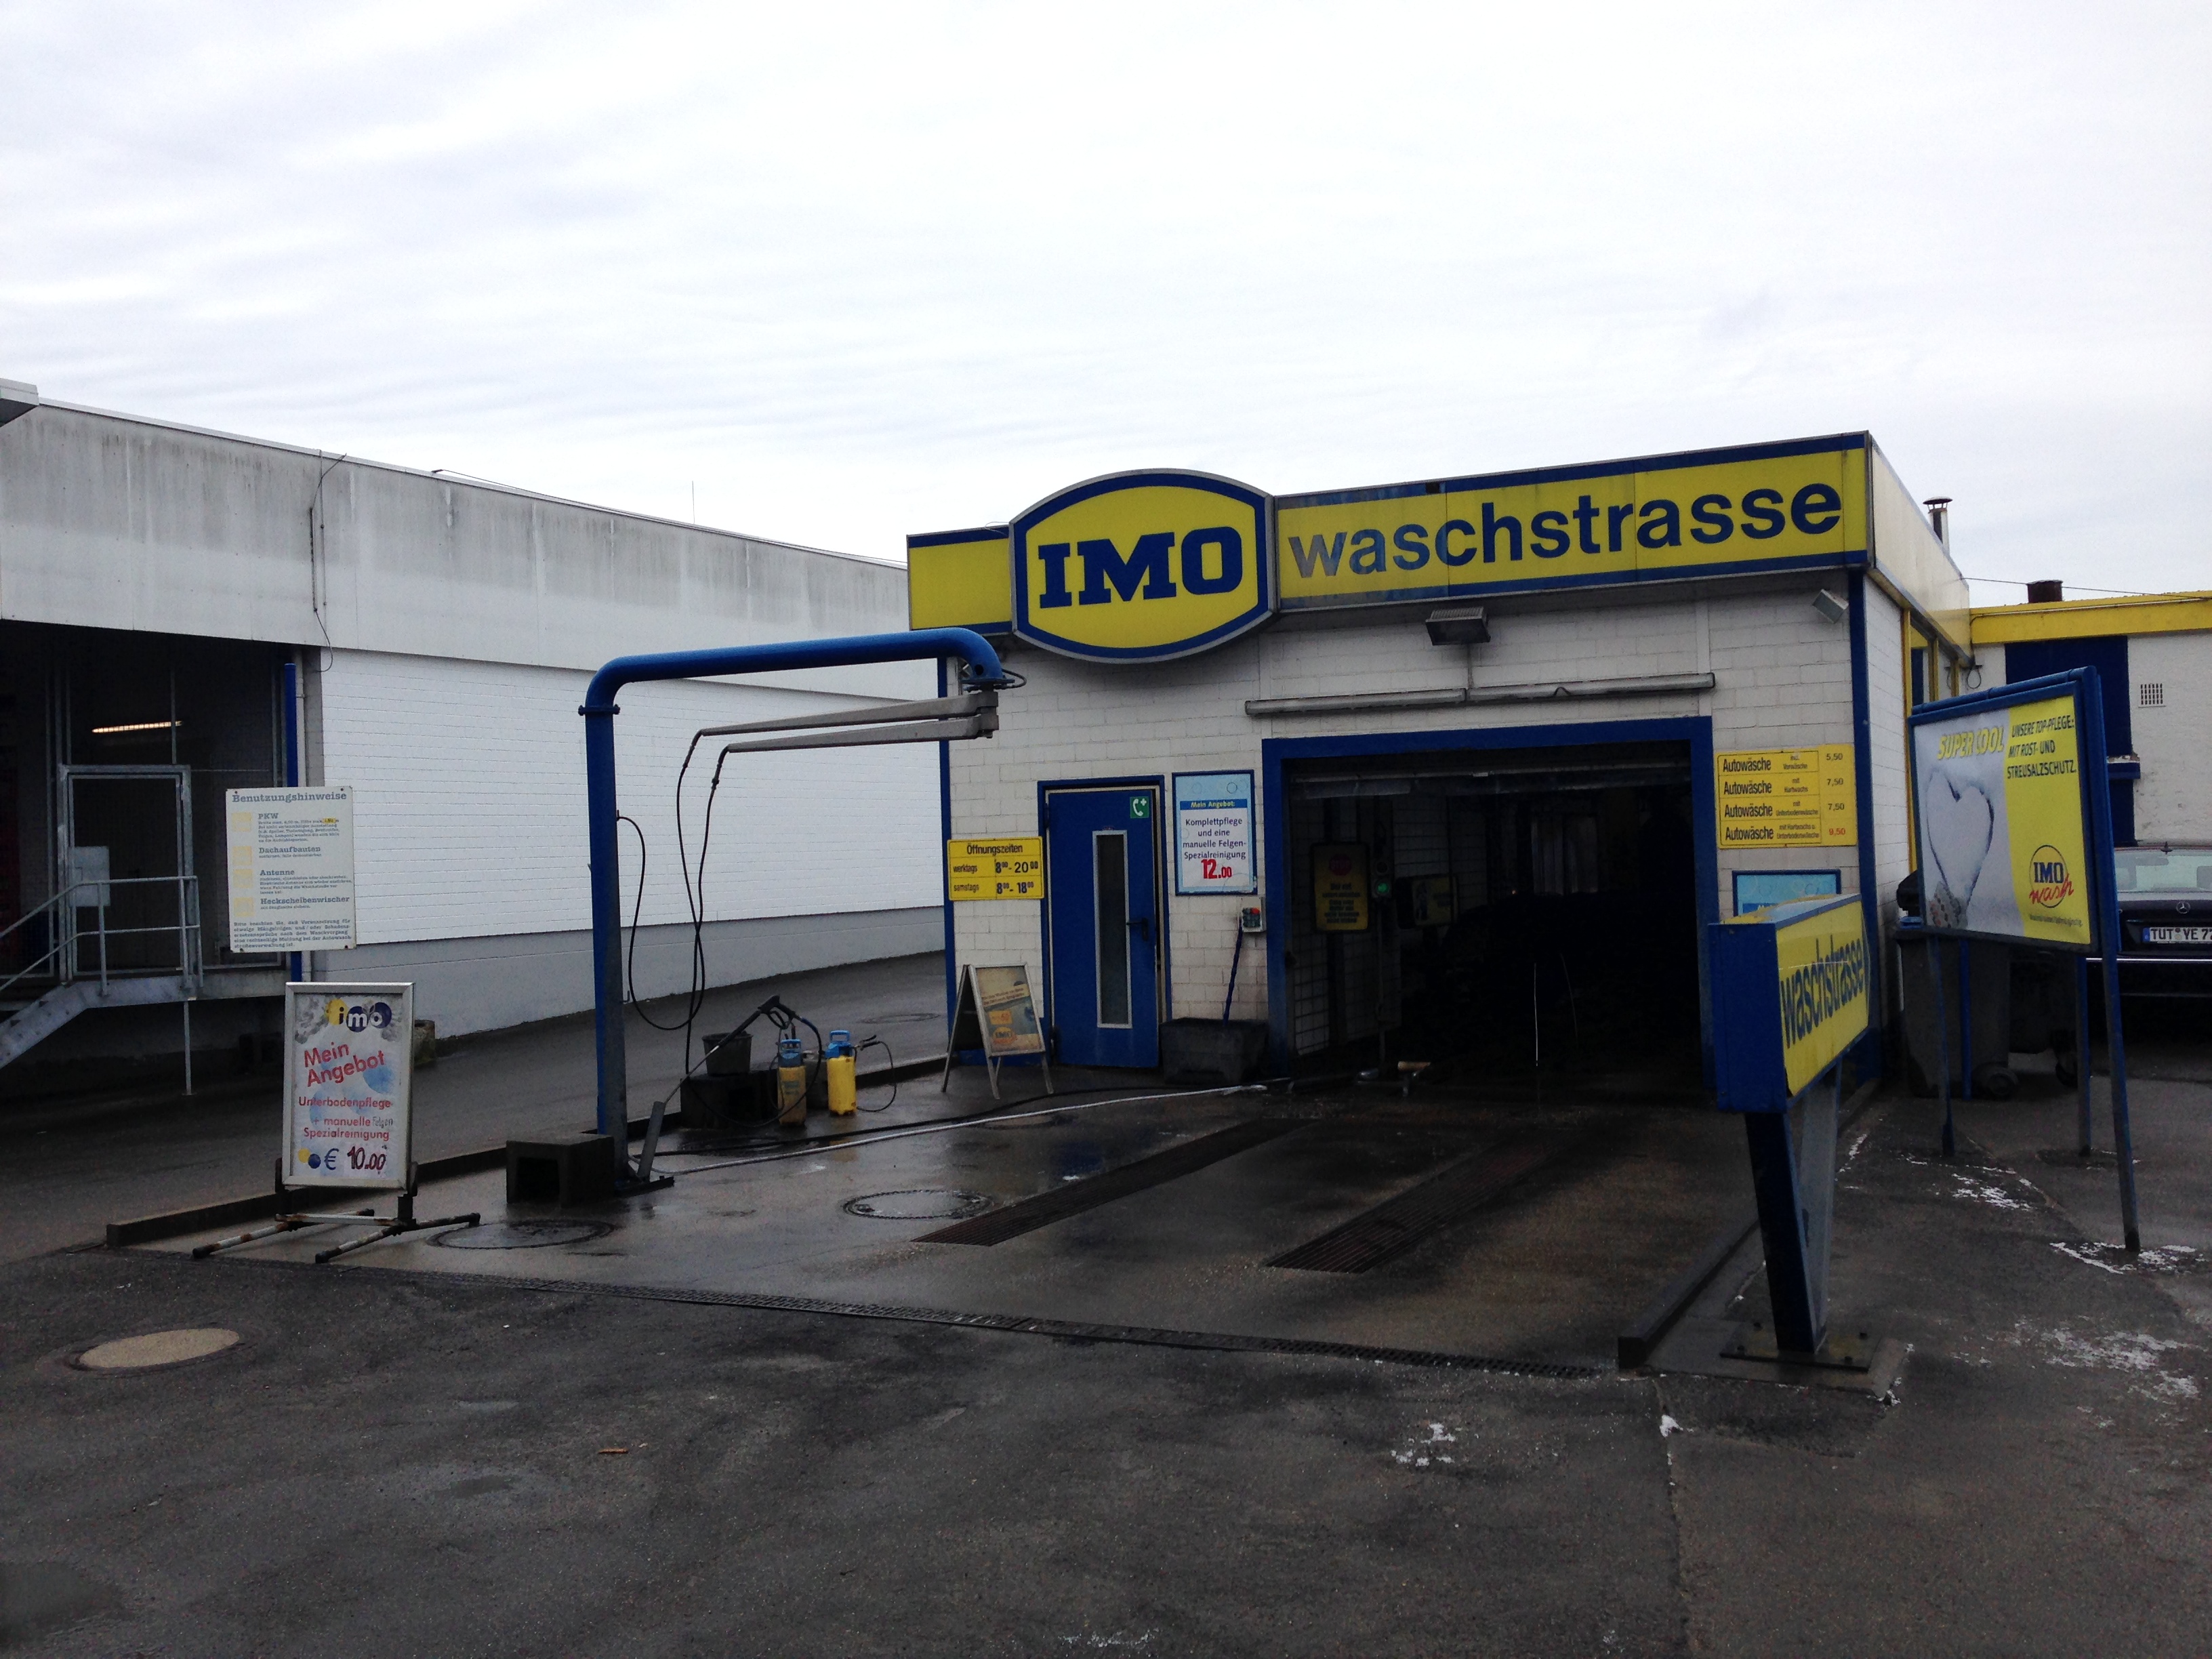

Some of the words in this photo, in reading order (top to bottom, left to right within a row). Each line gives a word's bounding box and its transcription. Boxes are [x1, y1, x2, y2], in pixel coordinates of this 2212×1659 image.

[1288, 482, 1841, 579] waschstrasse
[1038, 526, 1243, 609] IMO
[2012, 722, 2035, 737] UNSERE
[2036, 715, 2074, 733] TOP-PFLEGE:
[1937, 731, 1974, 760] SUPER
[1975, 726, 2004, 756] COOL
[2009, 745, 2021, 758] MIT
[2021, 742, 2039, 756] ROST-
[2040, 739, 2055, 754] UND
[1723, 757, 1771, 772] Autowäsche
[2007, 760, 2076, 779] STREUSALZSCHUTZ.
[1723, 780, 1772, 795] Autowäsche
[1826, 778, 1843, 786] 7,50
[232, 792, 347, 803] Benutzungshinweise
[1208, 800, 1235, 808] Angebot:
[1724, 803, 1773, 818] Autowäsche
[1828, 803, 1845, 811] 7,50
[1185, 817, 1242, 827] Komplettpflege
[1725, 826, 1774, 841] Autowäsche
[1828, 827, 1846, 836] 9,50
[966, 843, 1023, 856] Öffnungszeiten
[1183, 840, 1216, 848] manuelle
[1218, 840, 1247, 848] Felgen-
[1184, 851, 1246, 861] Spezialreinigung
[953, 863, 977, 874] werktags
[1201, 859, 1232, 879] 12.00
[2033, 862, 2064, 883] IMO
[954, 883, 979, 893] samstags
[2029, 874, 2074, 904] wash
[260, 896, 350, 905] Heckscheibenwischer
[2150, 928, 2173, 939] TUT
[2183, 928, 2198, 939] YE
[338, 1006, 383, 1027] imo
[304, 1042, 350, 1068] Mein
[307, 1050, 385, 1087] Angebot
[324, 1116, 371, 1126] manuelle
[304, 1128, 390, 1141] Spezialreinigung
[324, 1148, 340, 1170] €
[347, 1146, 386, 1170] 10.00
